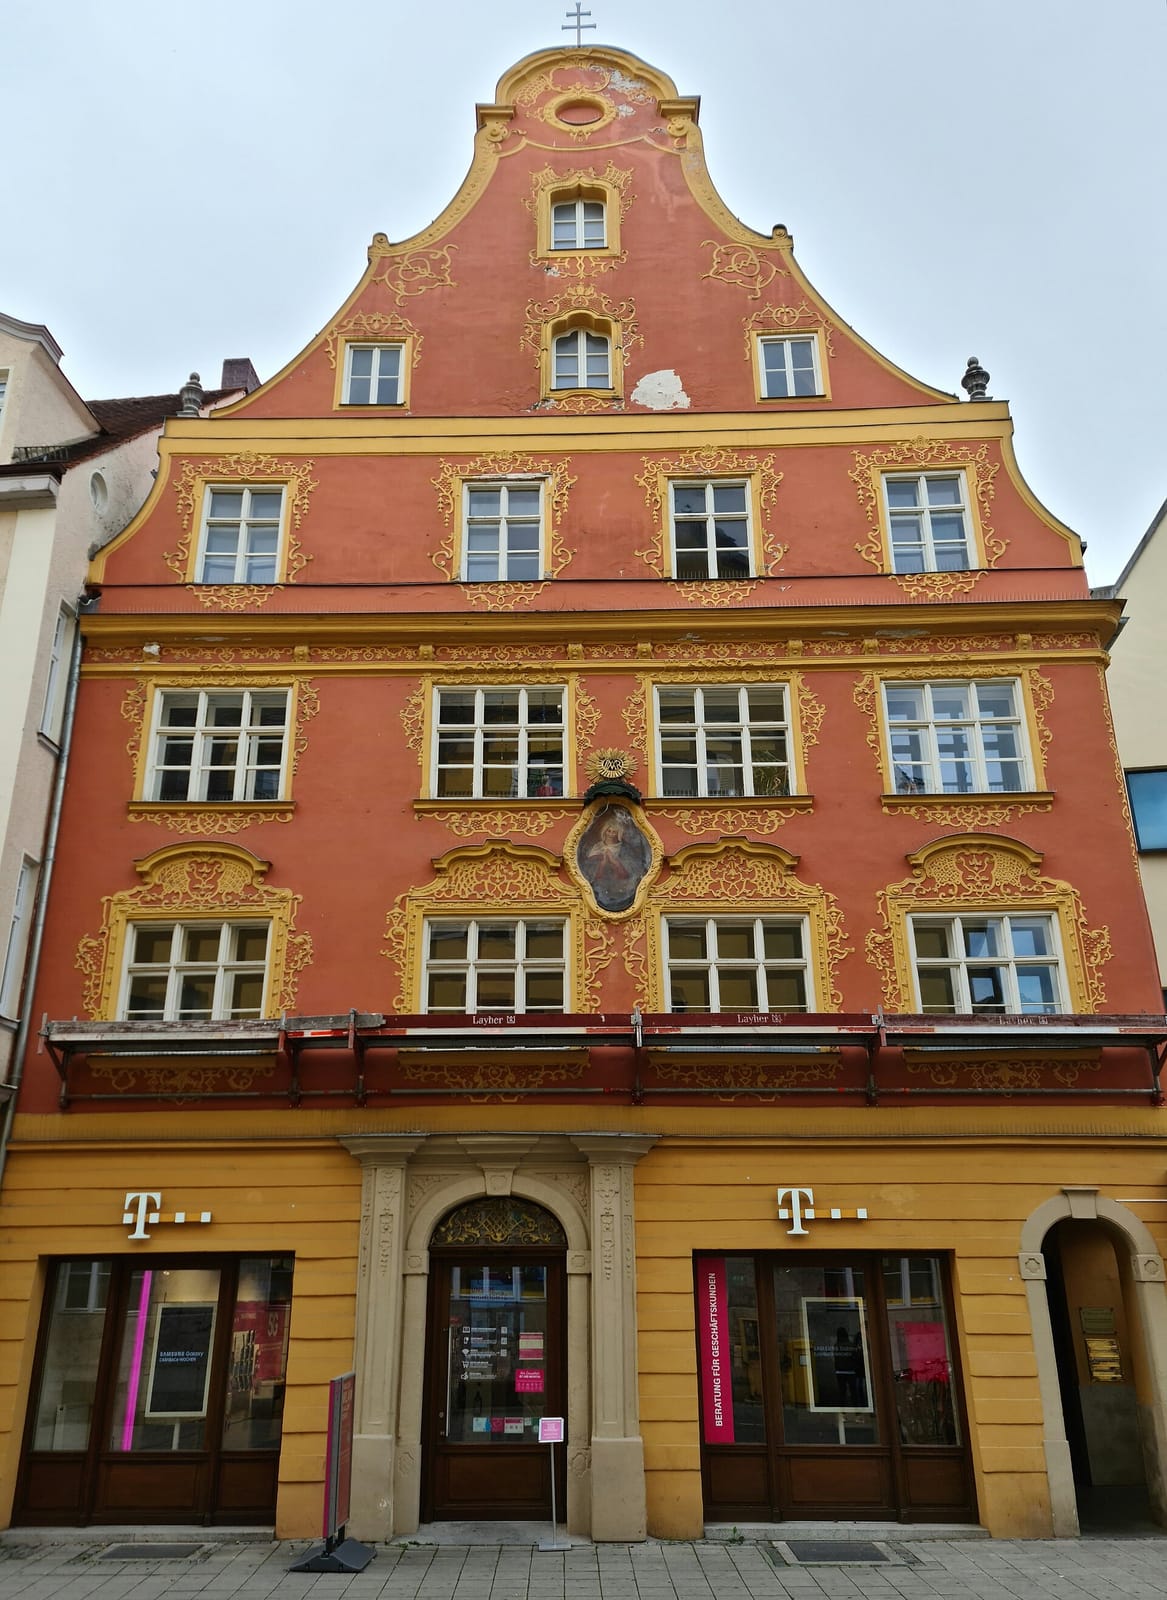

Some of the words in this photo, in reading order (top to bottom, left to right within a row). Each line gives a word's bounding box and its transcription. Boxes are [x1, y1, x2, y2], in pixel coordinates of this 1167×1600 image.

[473, 1016, 503, 1026] Layher
[737, 1014, 769, 1025] Layher
[999, 1015, 1034, 1025] Laher
[123, 1191, 162, 1240] T
[777, 1187, 814, 1236] T
[708, 1272, 720, 1357] GESCHÄFTSKUNDEN
[710, 1358, 720, 1377] FÜR
[711, 1377, 723, 1427] BERATUNG
